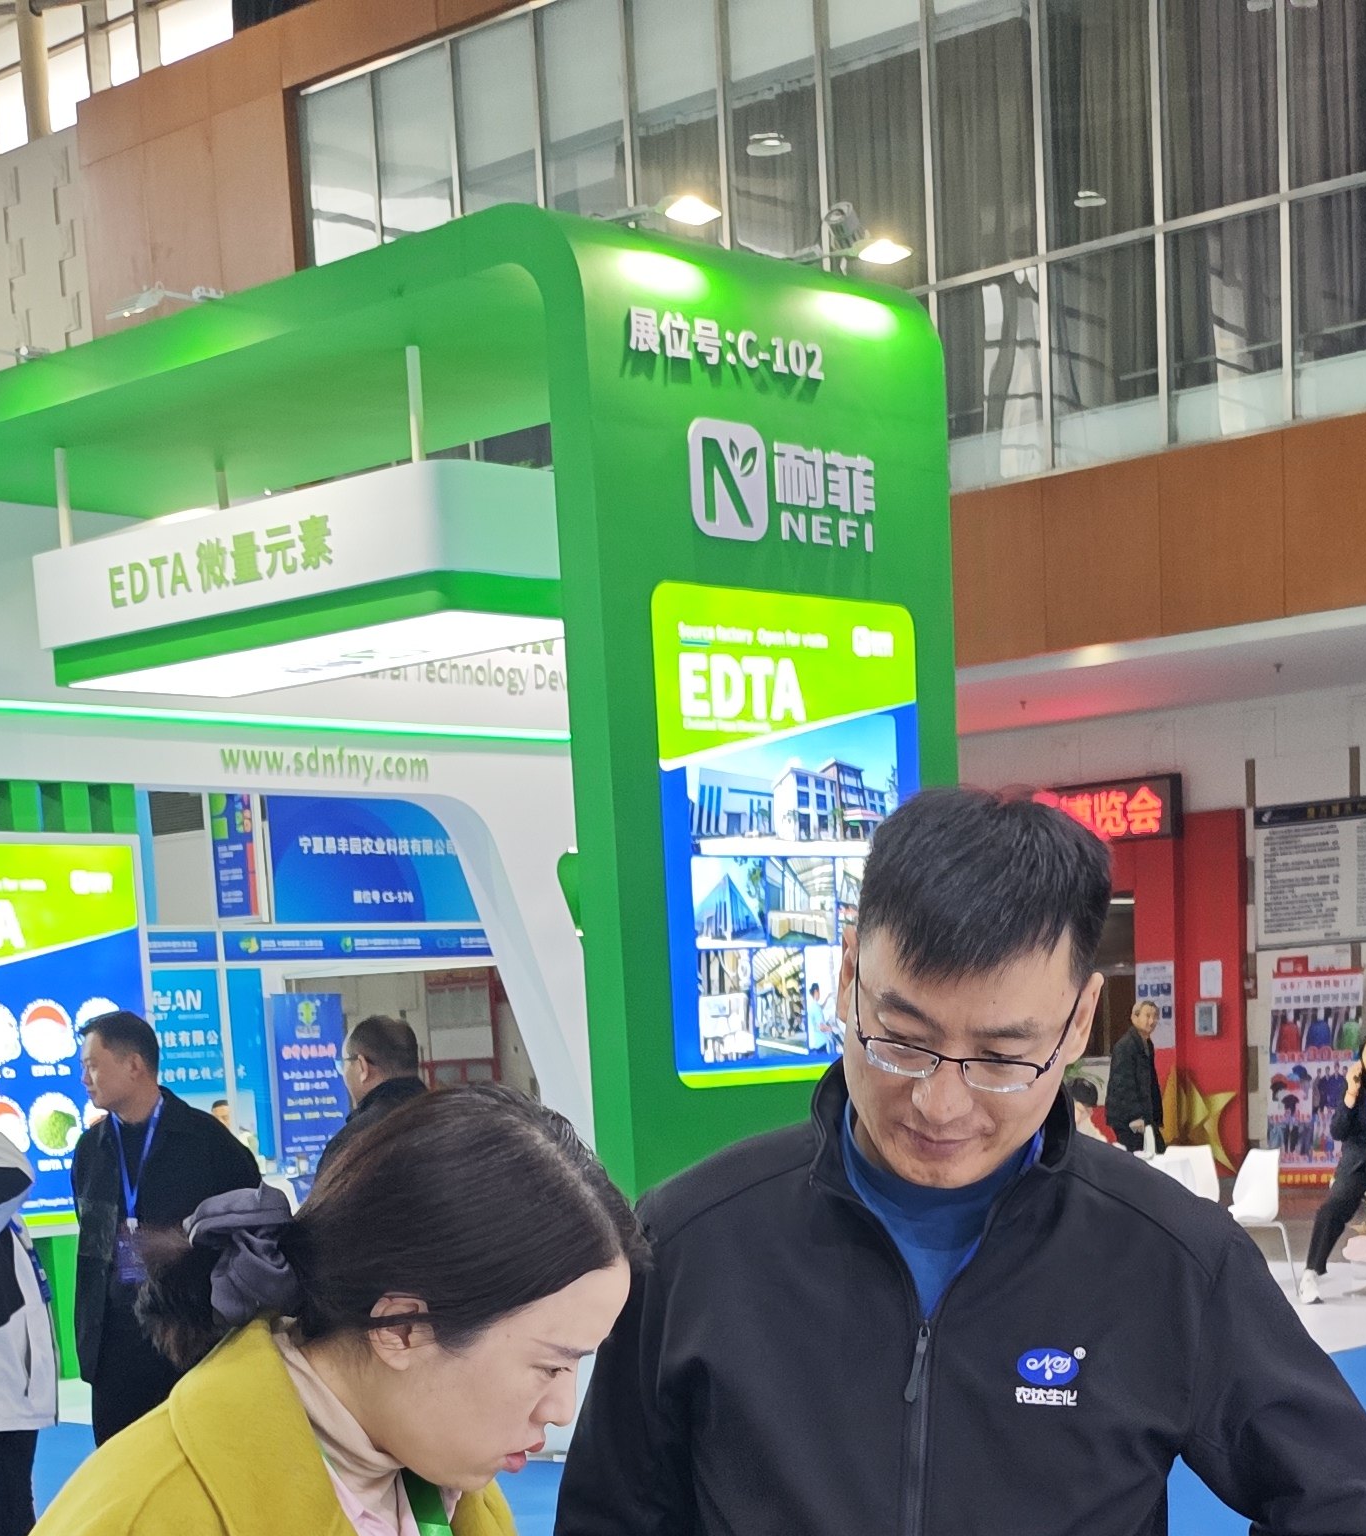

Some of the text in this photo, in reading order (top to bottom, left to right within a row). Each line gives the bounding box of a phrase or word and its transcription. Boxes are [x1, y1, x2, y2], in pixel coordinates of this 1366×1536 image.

[629, 306, 825, 380] 展位号:C-102
[773, 441, 875, 515] 耐菲
[108, 514, 334, 609] EDTA 微量元素
[781, 512, 875, 553] NEFI
[678, 651, 807, 724] EDTA
[220, 744, 429, 782] www.sdnfny.com
